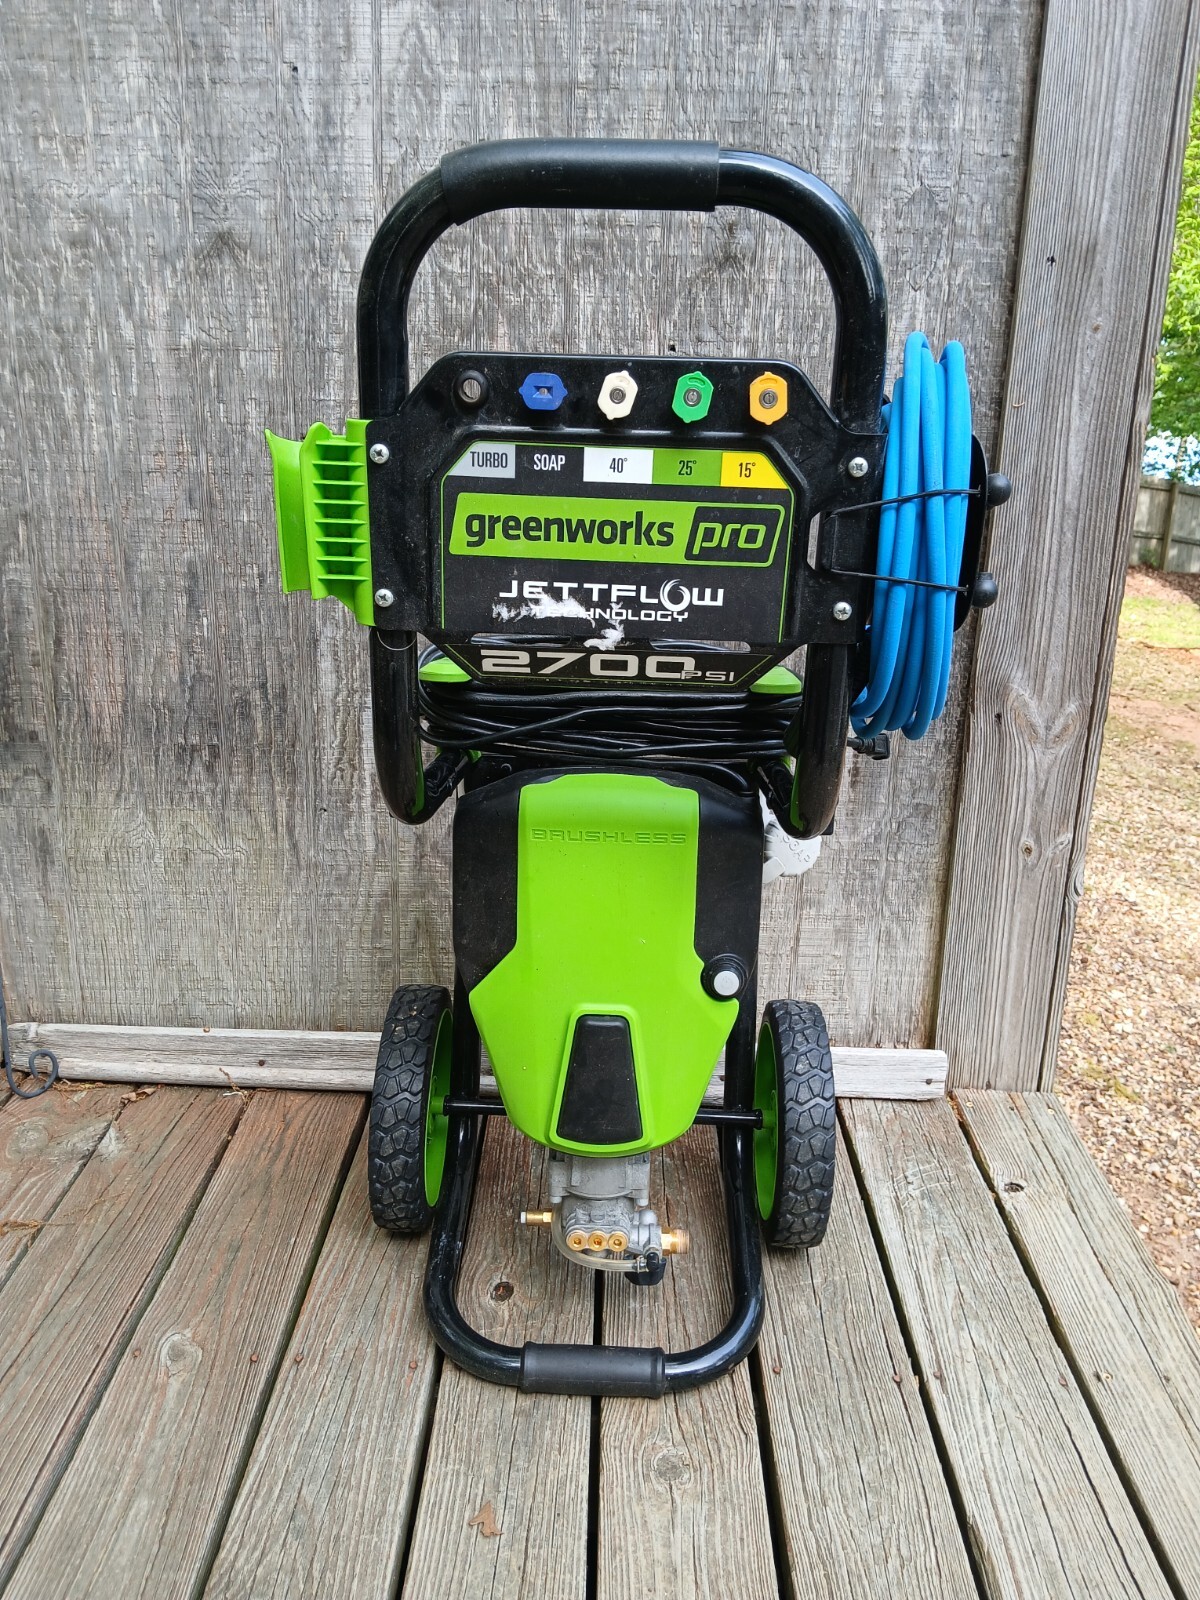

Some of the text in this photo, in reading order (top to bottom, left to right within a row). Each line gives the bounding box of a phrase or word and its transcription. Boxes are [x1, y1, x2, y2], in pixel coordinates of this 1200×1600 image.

[470, 451, 508, 469] TURBO
[533, 454, 566, 472] SOAP
[609, 457, 629, 474] 40°
[678, 460, 698, 476] 25°
[738, 462, 757, 479] 15°
[465, 511, 767, 555] greenworks pro
[498, 579, 724, 611] JETTFLOW
[480, 649, 735, 682] 2700 PSI
[531, 828, 687, 845] BRUSHLESS
